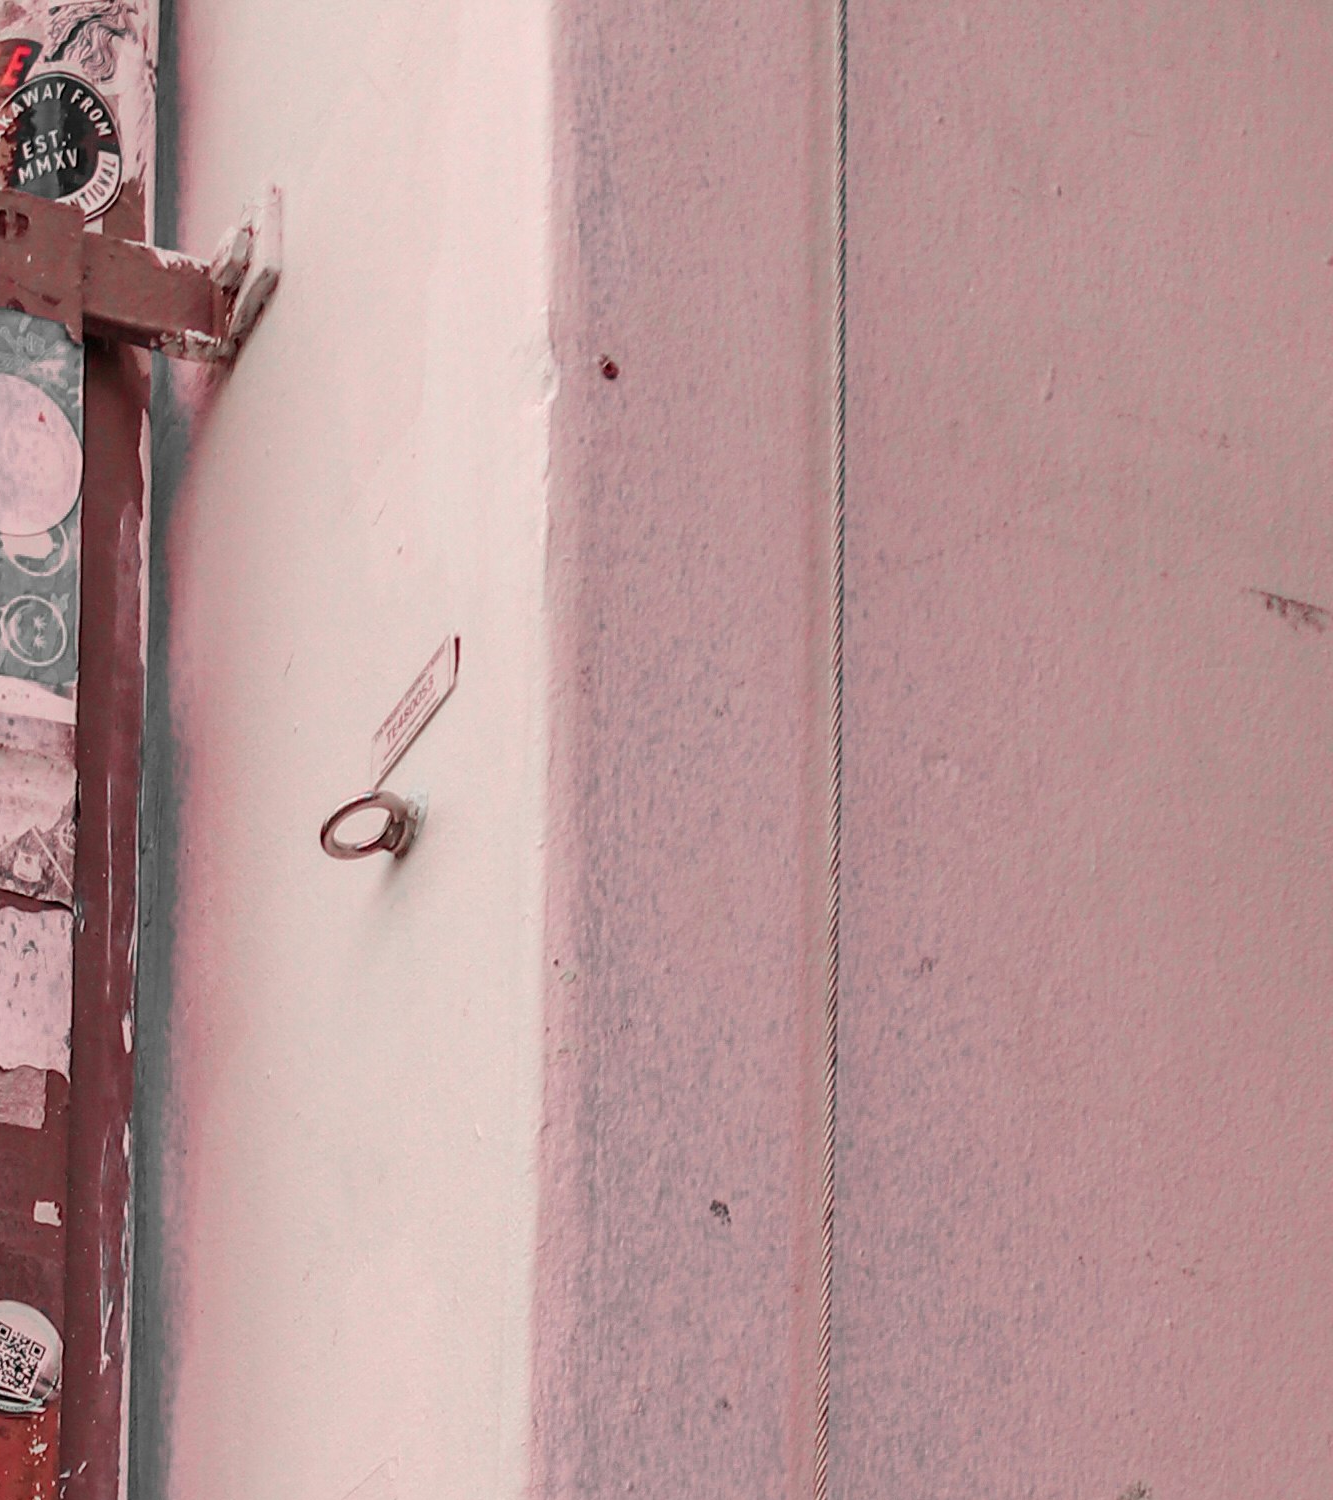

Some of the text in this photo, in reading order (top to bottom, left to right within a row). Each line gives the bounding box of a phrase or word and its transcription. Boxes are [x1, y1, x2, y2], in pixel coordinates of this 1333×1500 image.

[69, 88, 112, 138] FROM
[21, 130, 67, 161] EST.
[18, 148, 79, 185] MMXV
